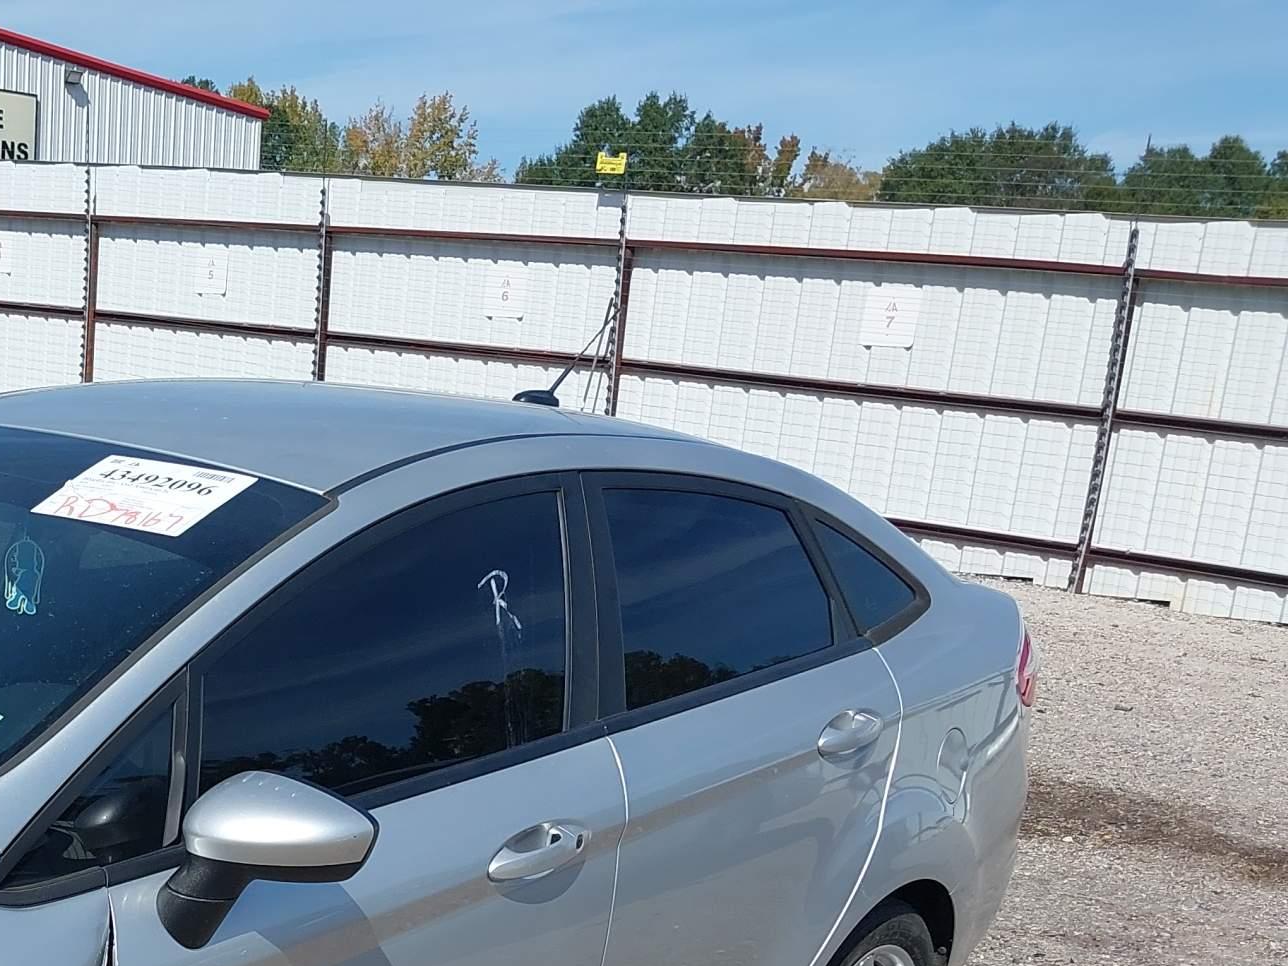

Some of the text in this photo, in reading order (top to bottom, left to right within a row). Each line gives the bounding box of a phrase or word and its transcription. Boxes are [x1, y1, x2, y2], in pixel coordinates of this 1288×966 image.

[207, 270, 214, 280] 5
[501, 290, 509, 301] 6
[885, 315, 896, 328] 7
[99, 468, 213, 496] 43492096
[477, 569, 522, 630] R
